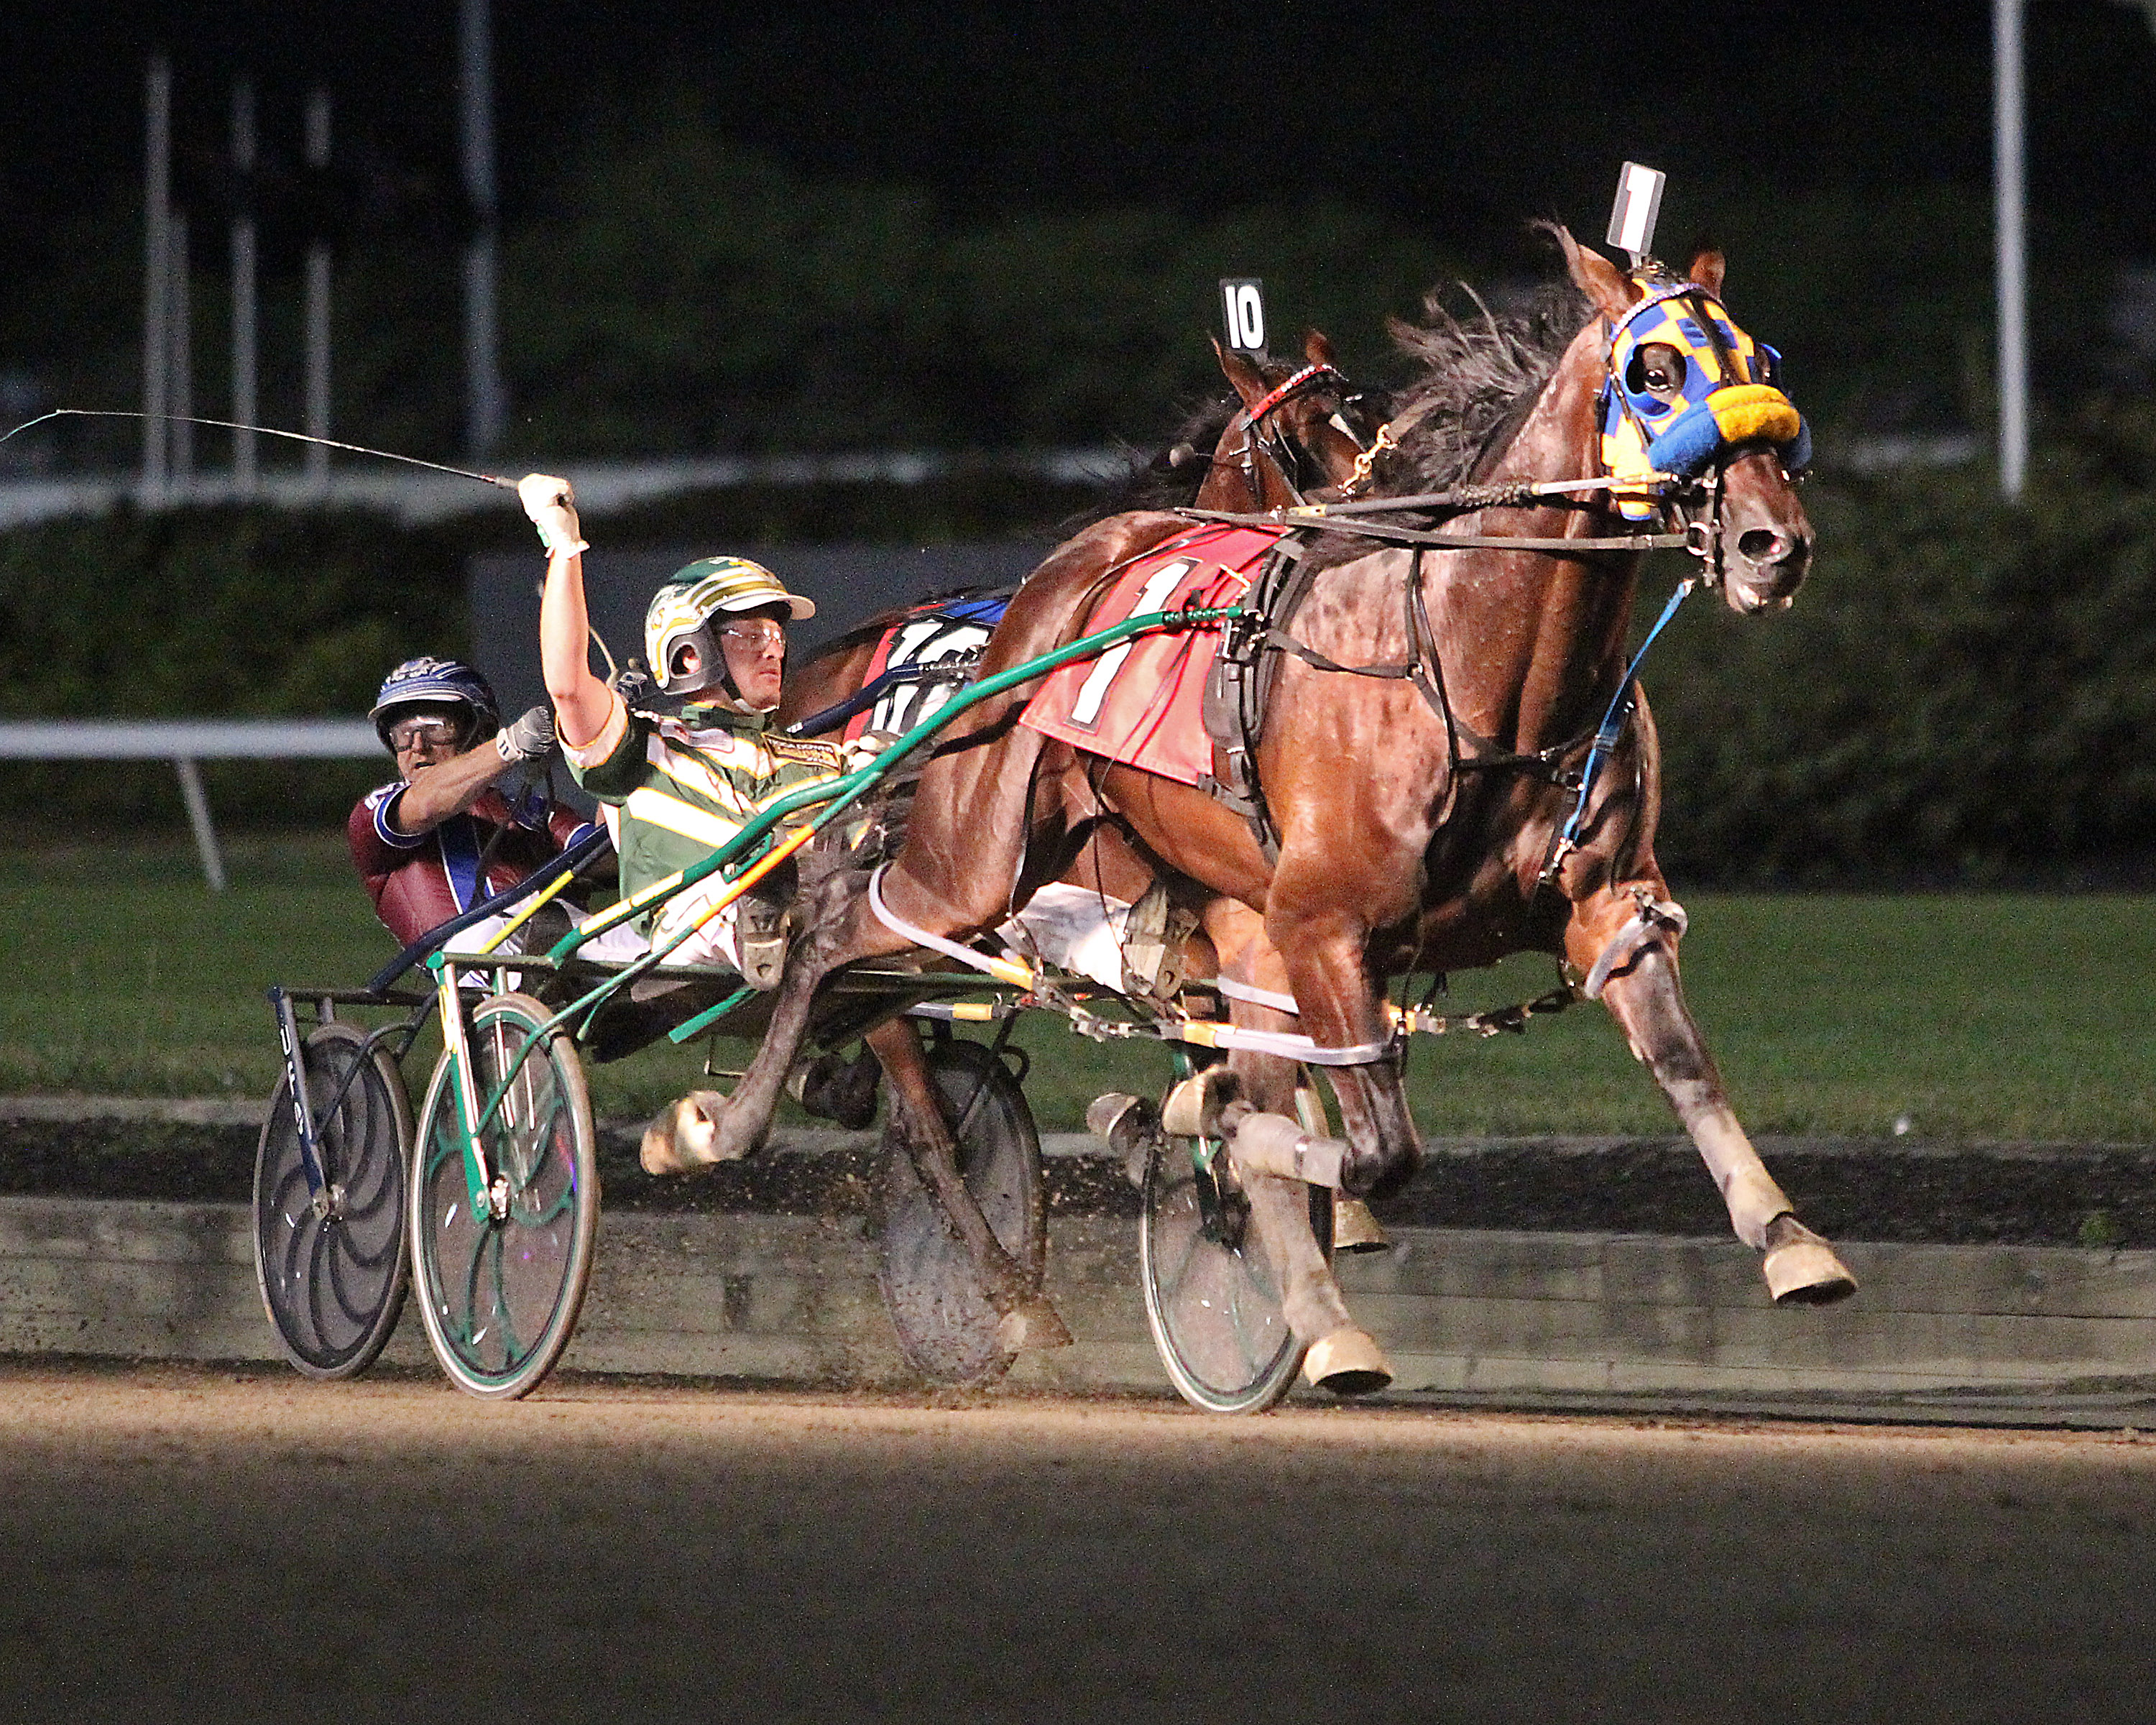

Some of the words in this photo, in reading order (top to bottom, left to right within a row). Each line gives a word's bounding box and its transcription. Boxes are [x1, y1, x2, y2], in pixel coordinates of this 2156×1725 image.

[1619, 165, 1657, 253] 1
[1225, 285, 1264, 349] 10
[1071, 561, 1190, 724] 1
